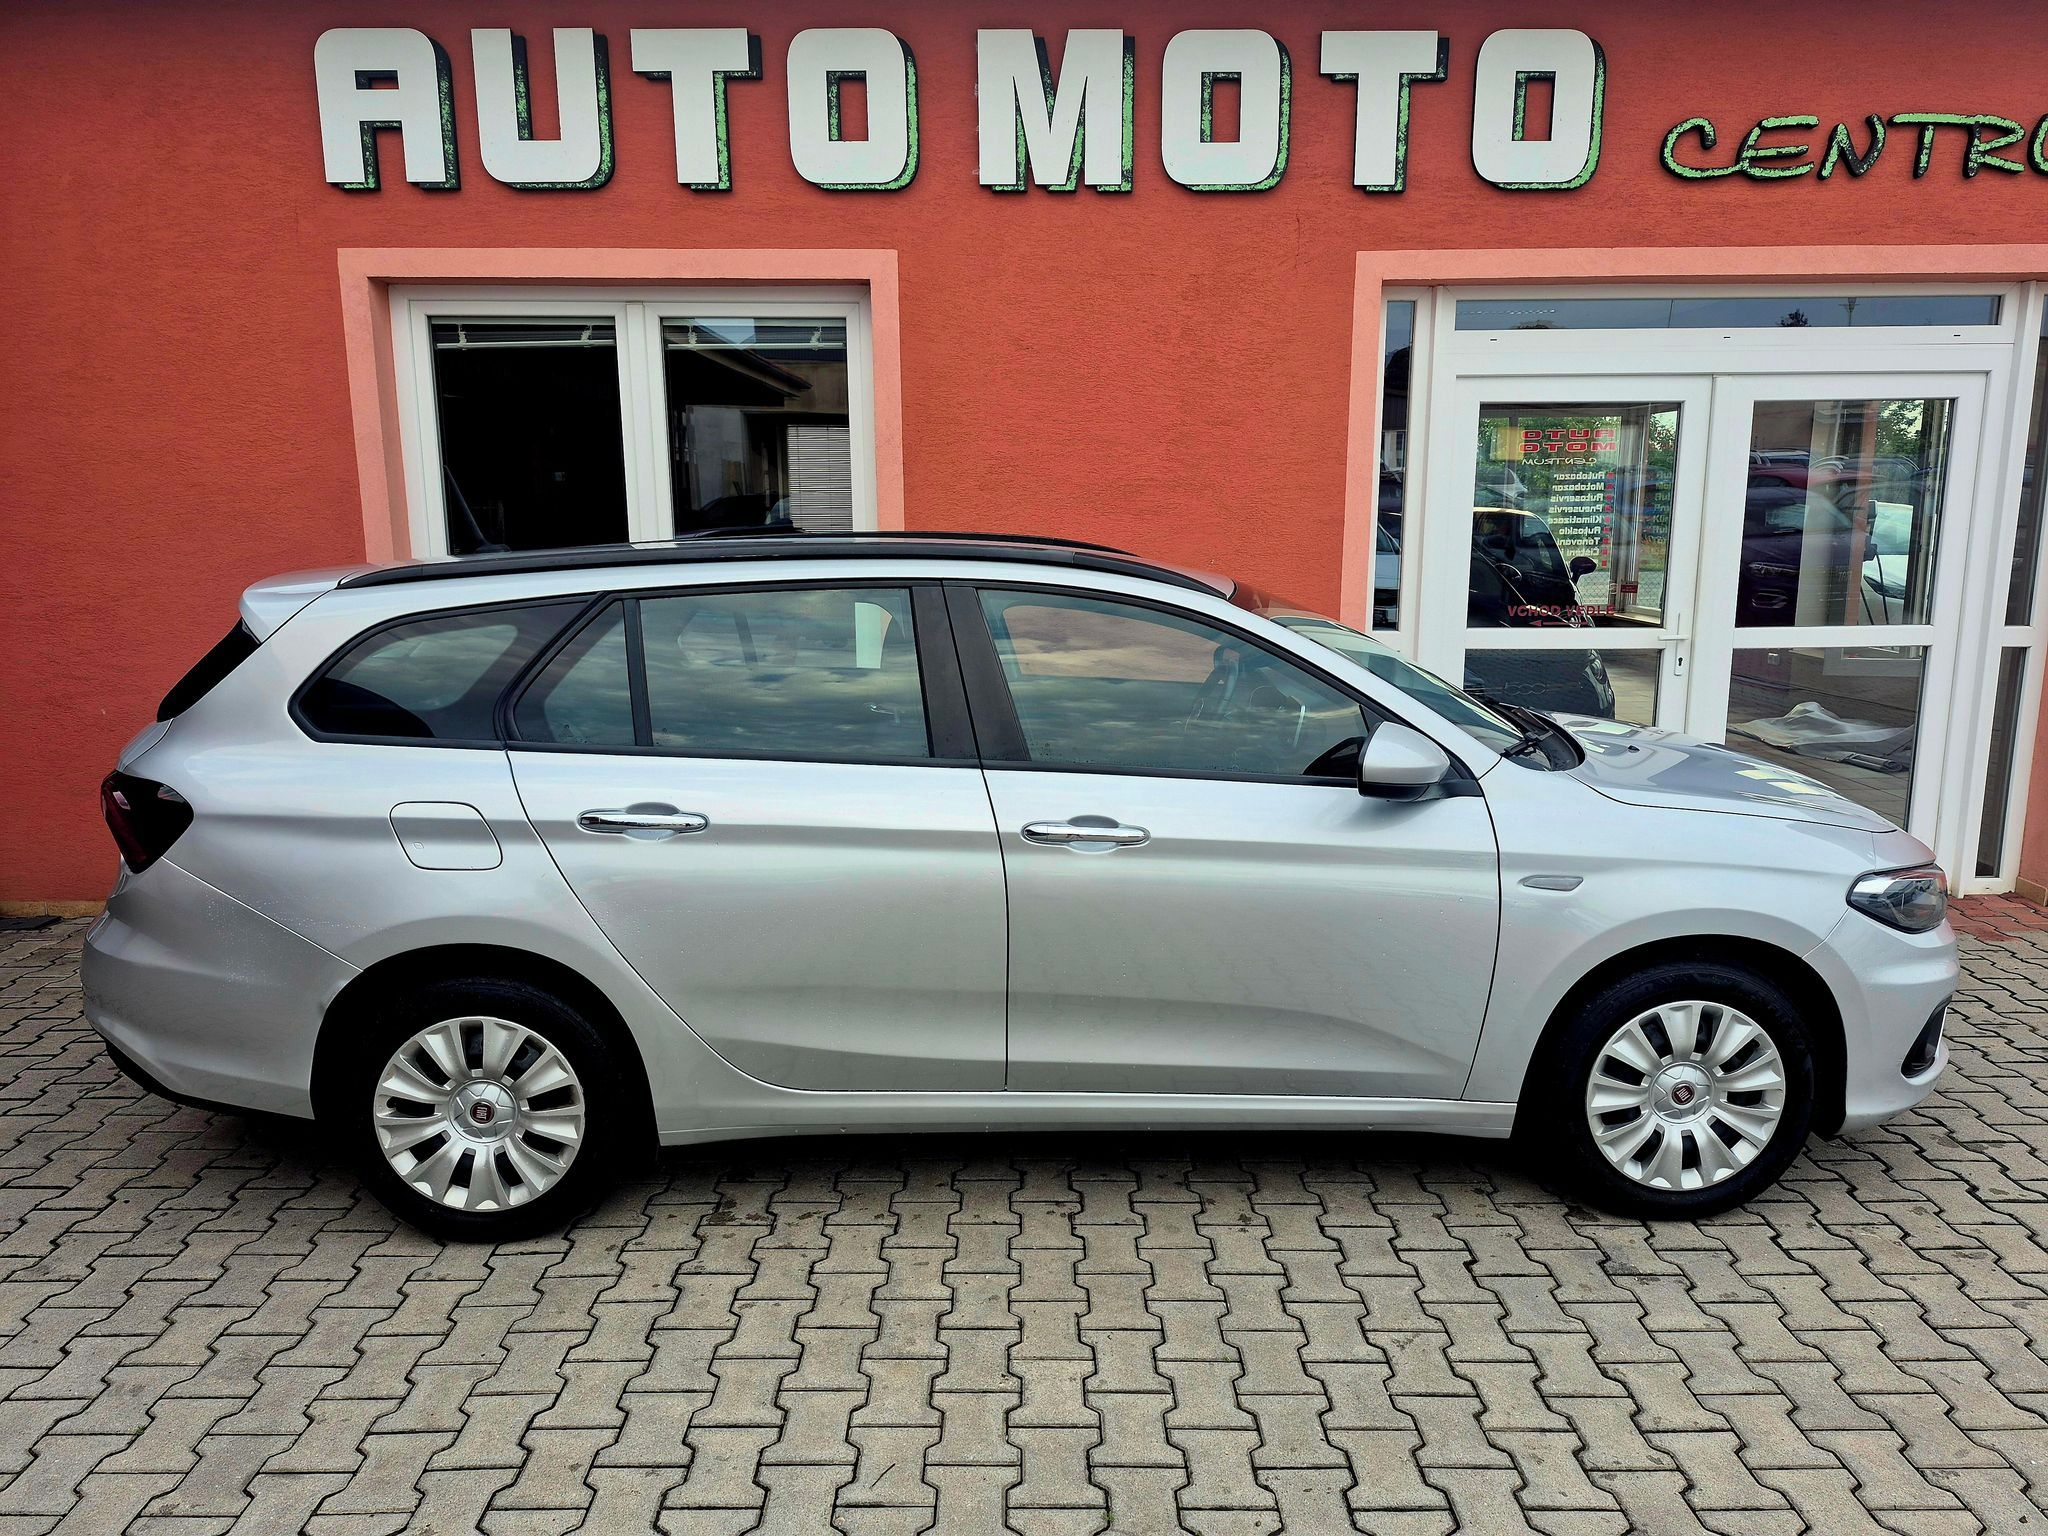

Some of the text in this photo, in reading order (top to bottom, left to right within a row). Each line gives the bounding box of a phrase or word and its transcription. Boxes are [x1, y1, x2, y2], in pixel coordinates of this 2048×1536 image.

[314, 27, 1607, 193] AUTO MOTO
[1507, 604, 1560, 617] VCHOD
